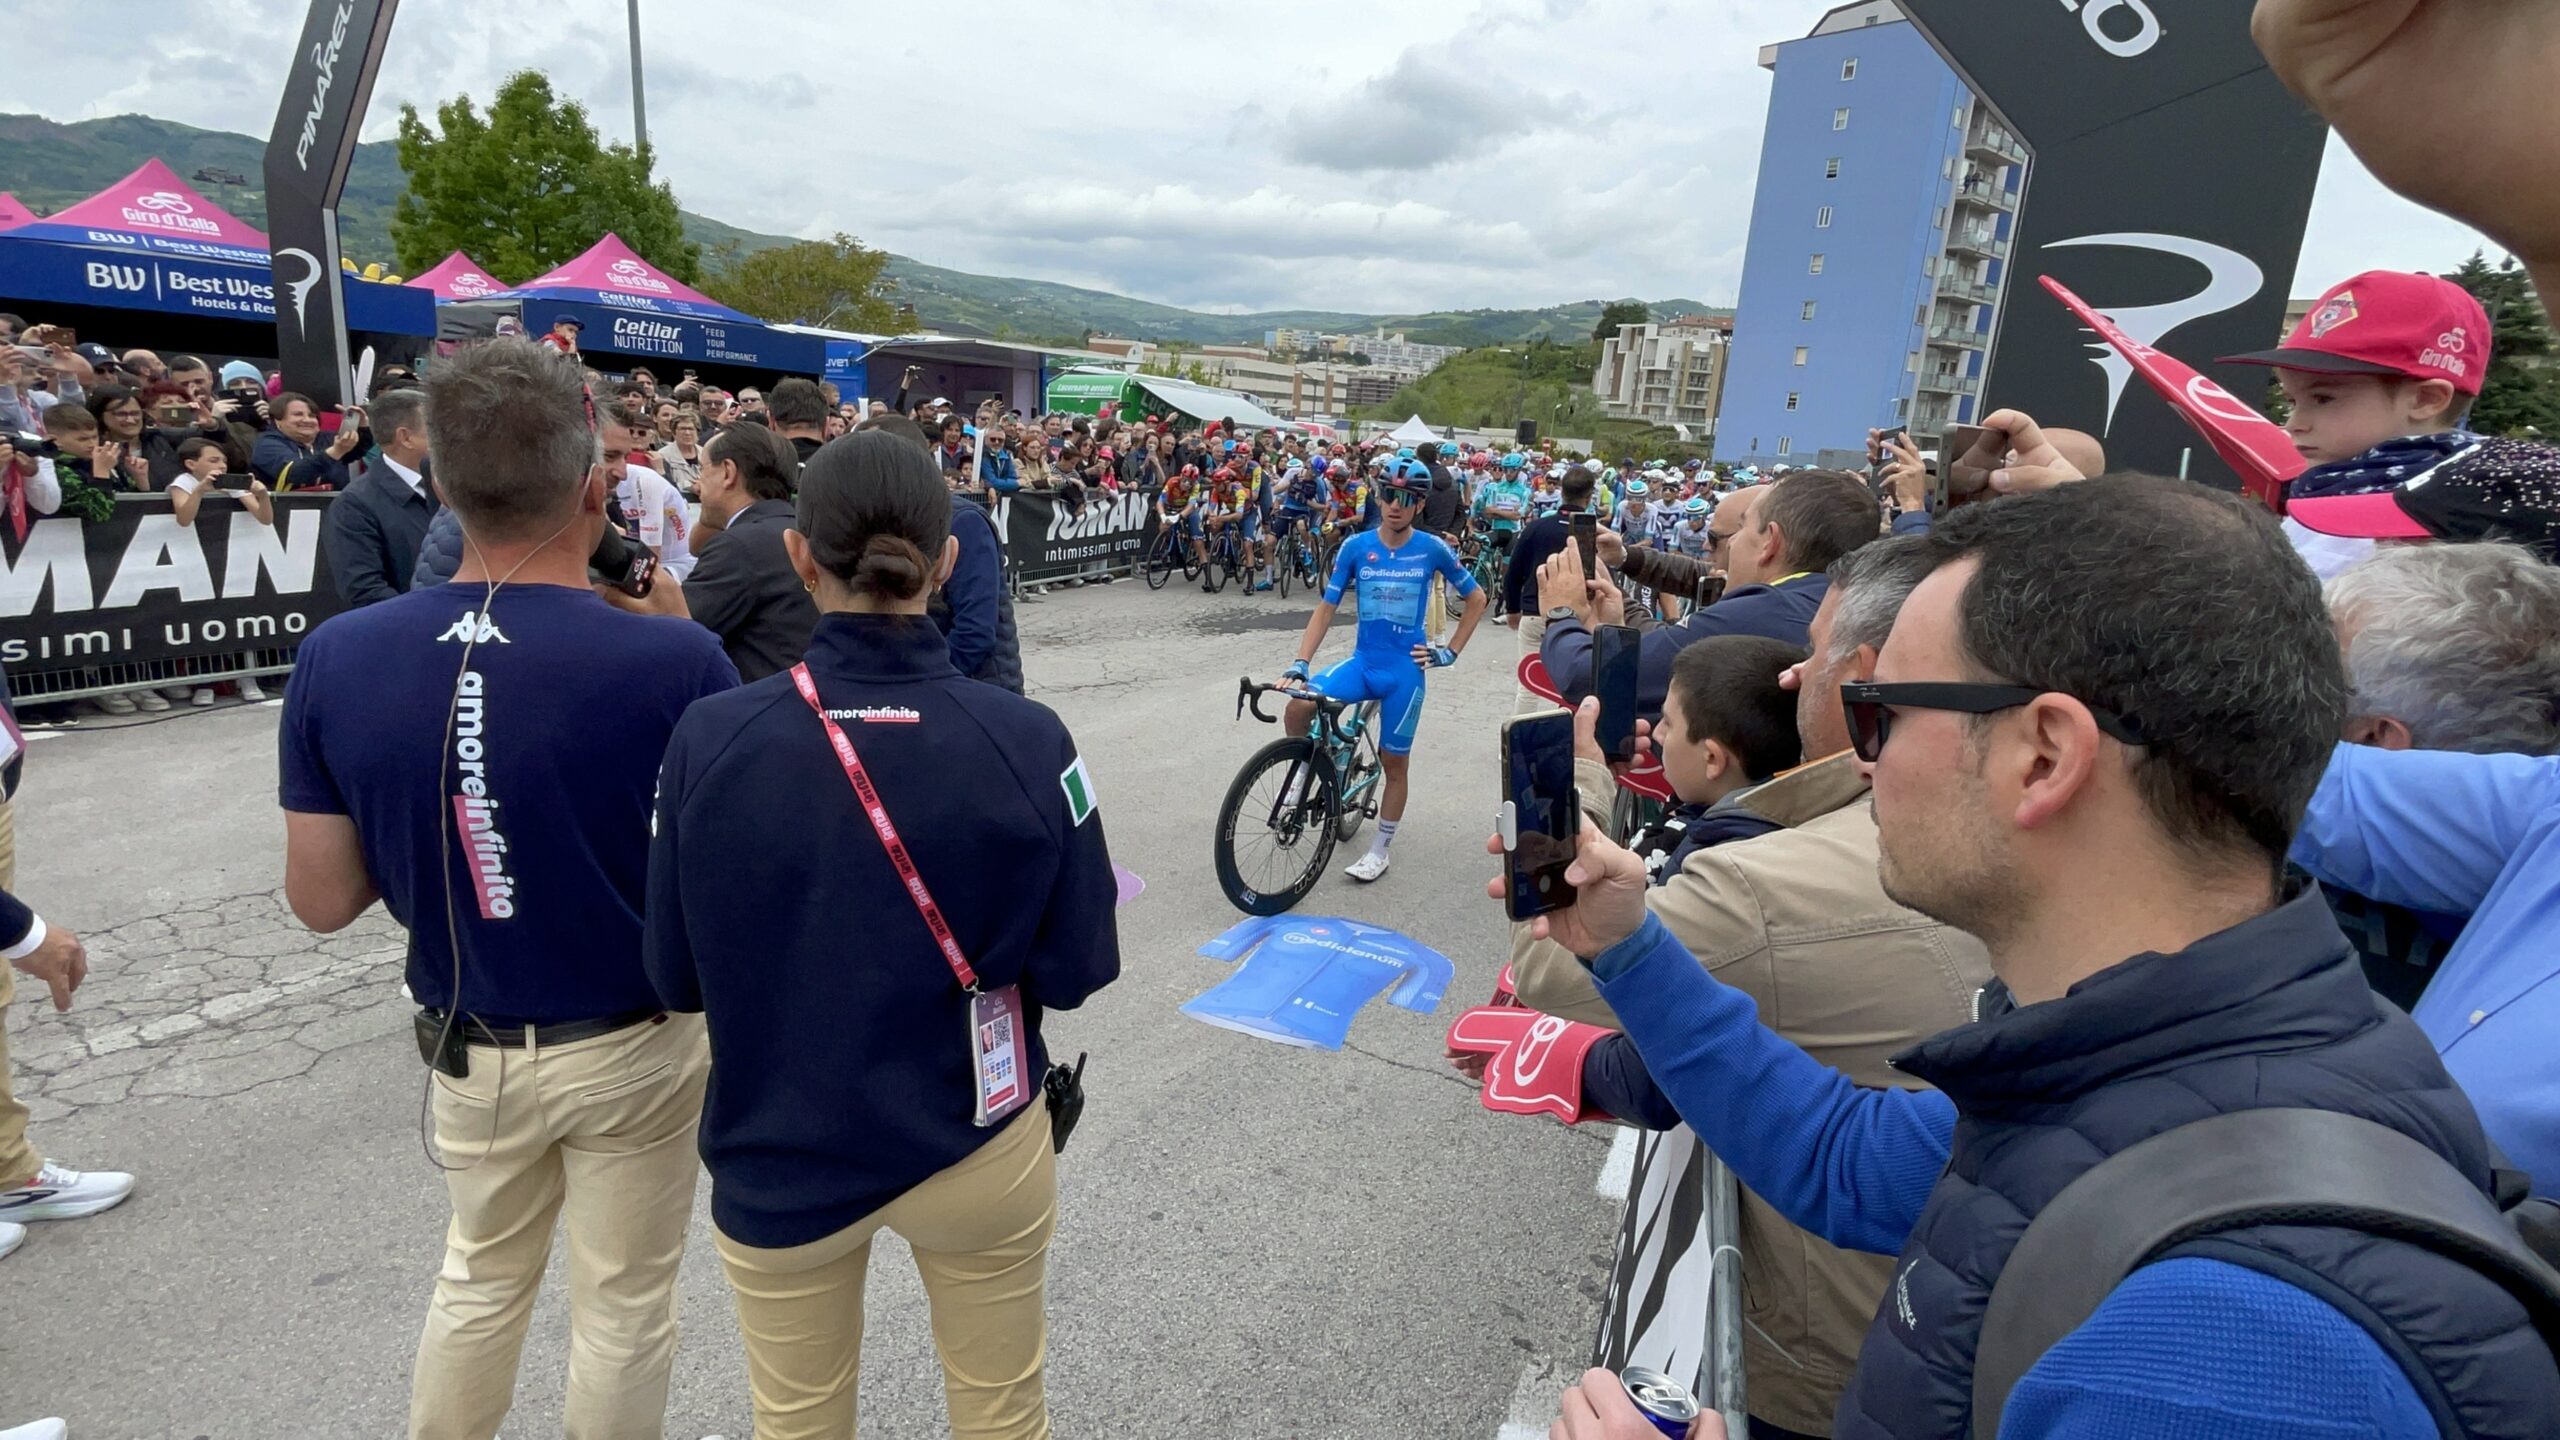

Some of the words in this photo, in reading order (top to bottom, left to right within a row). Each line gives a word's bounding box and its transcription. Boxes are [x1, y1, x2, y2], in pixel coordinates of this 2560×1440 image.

[296, 0, 354, 171] PINAREL
[121, 207, 160, 225] Giro
[87, 230, 136, 244] BW
[153, 239, 200, 250] Best
[86, 262, 146, 291] BW
[169, 271, 223, 294] Best
[191, 295, 237, 310] Hotels
[239, 301, 250, 312] &
[614, 317, 682, 340] Cetilar
[705, 327, 726, 338] FEED
[614, 335, 683, 354] NUTRITION
[706, 339, 726, 348] YOUR
[706, 349, 758, 363] PERFORMANCE
[1360, 566, 1424, 580] mediolanum
[164, 612, 307, 646] uomo
[457, 671, 514, 919] amoreinfinito
[1282, 931, 1404, 969] mediolanum
